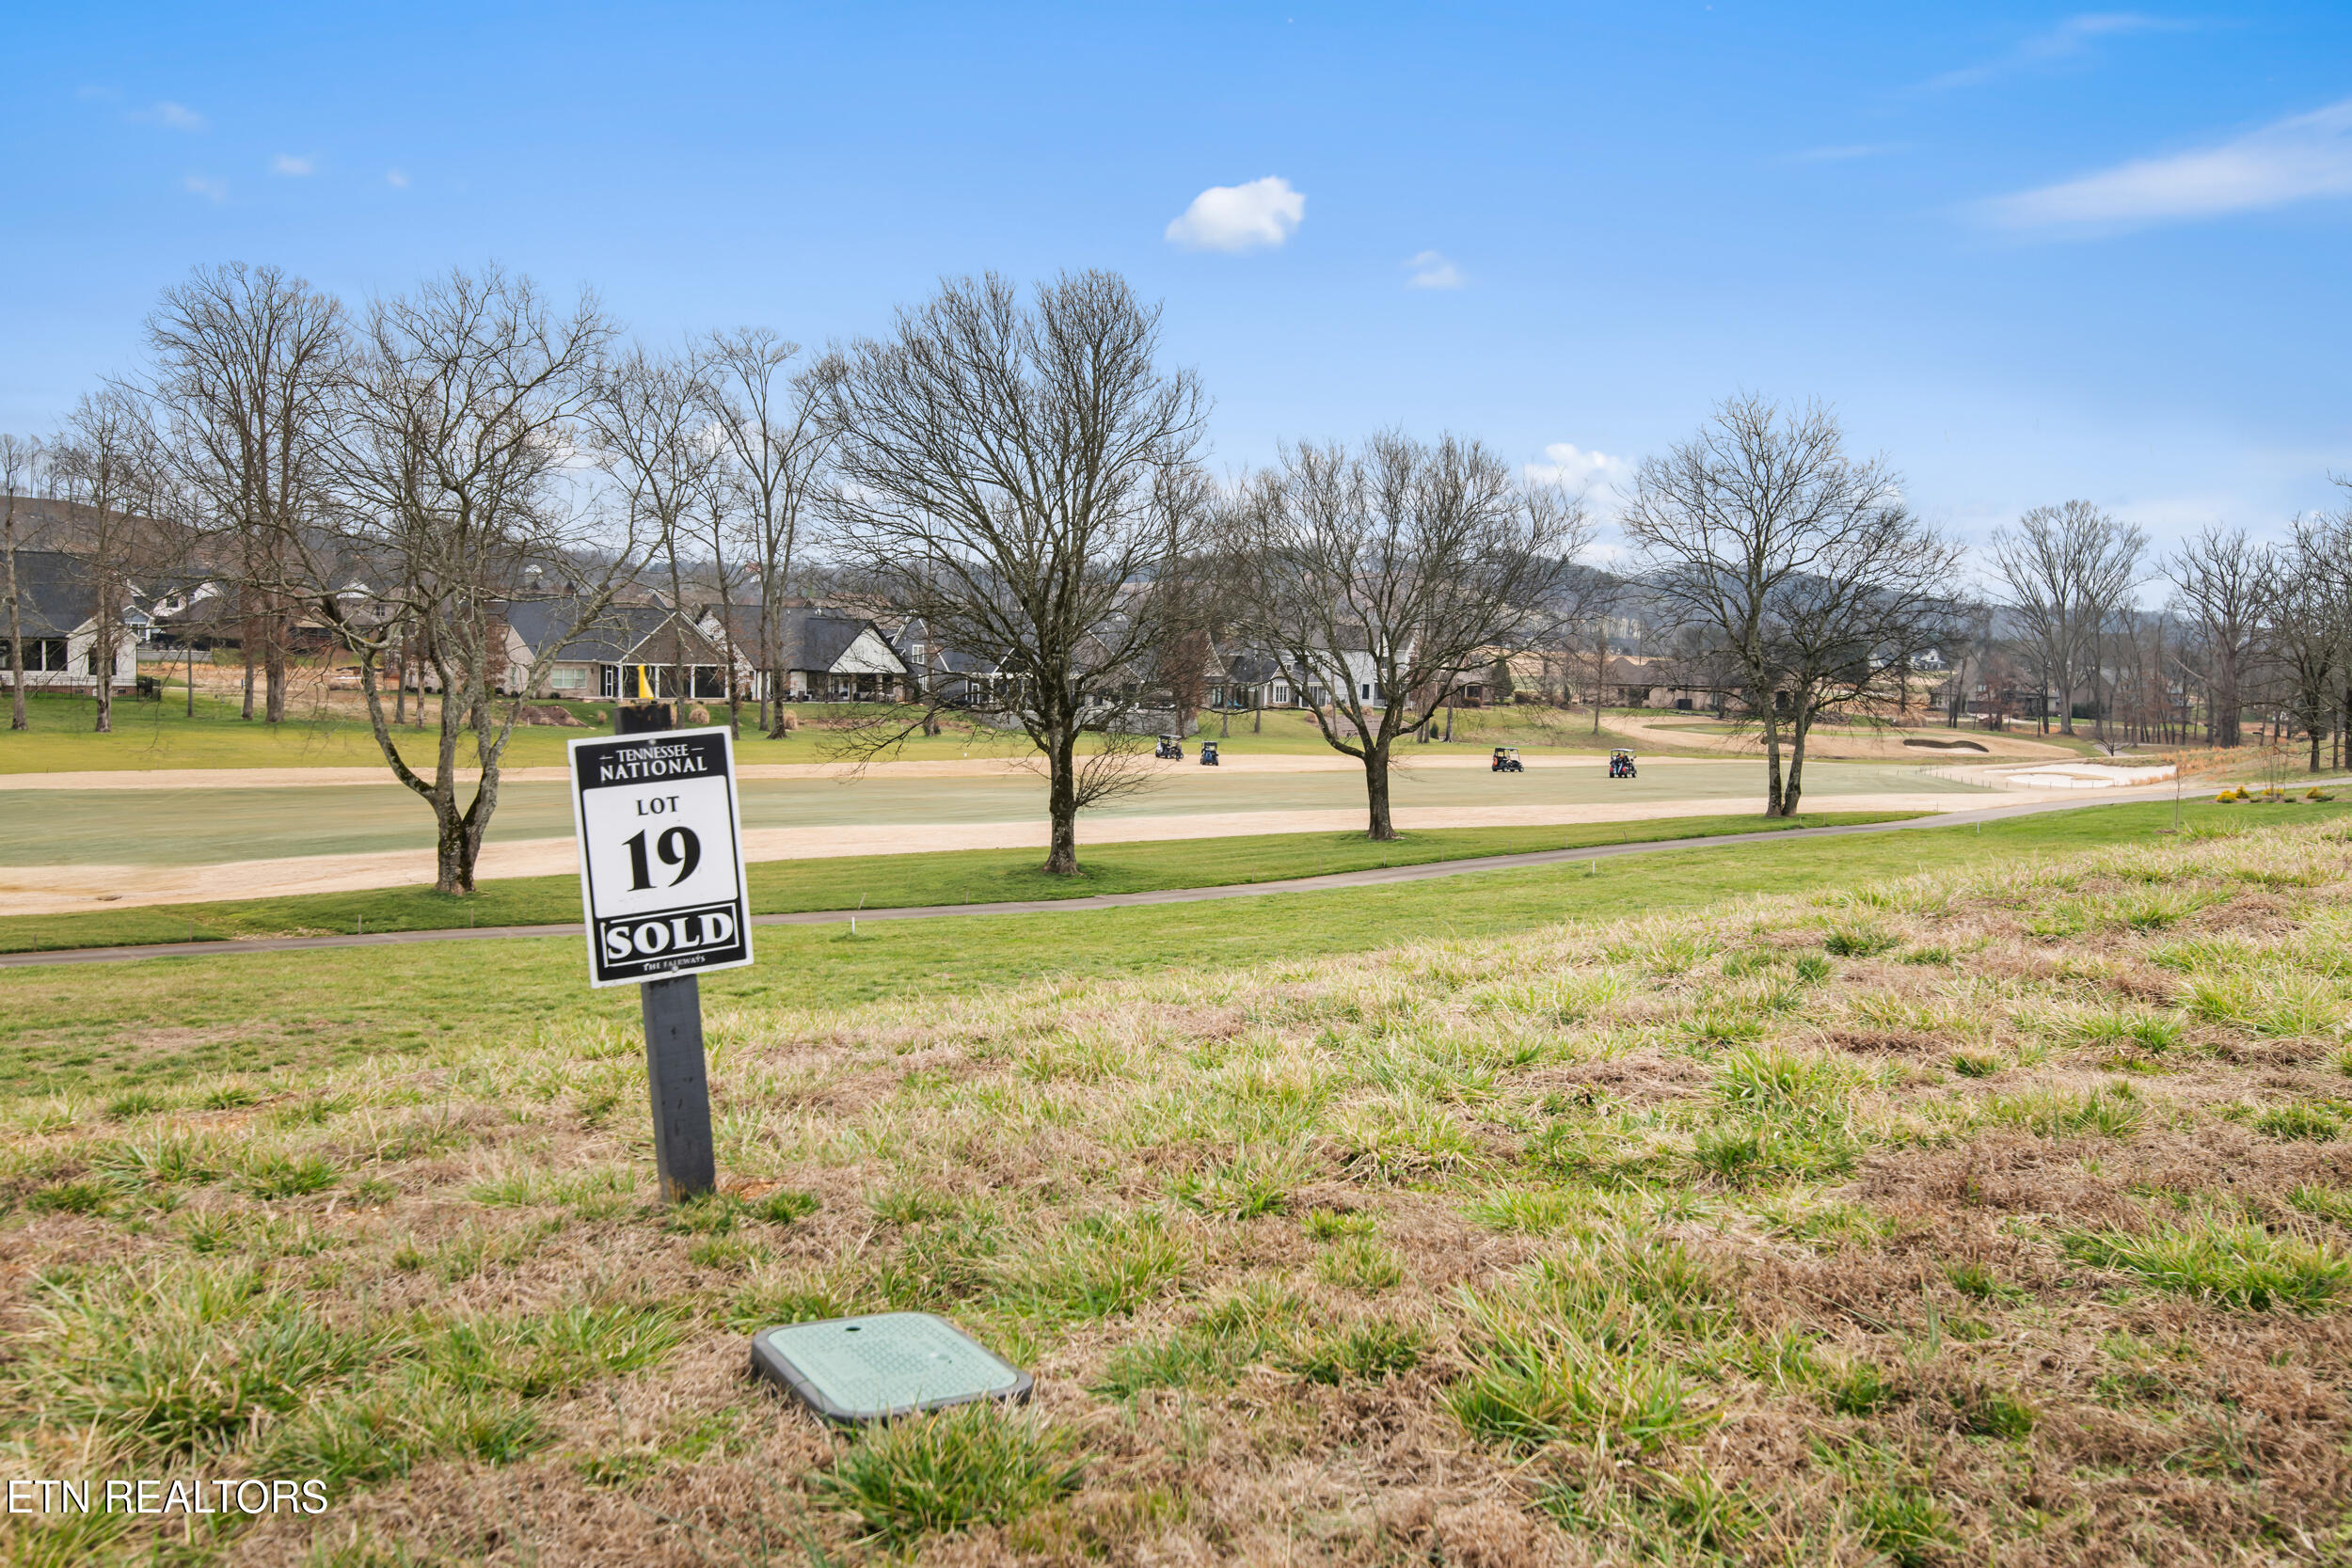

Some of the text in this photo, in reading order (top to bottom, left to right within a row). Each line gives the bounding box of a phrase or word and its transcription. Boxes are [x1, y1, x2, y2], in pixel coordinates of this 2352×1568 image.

[616, 744, 689, 763] TENNESSEE
[599, 756, 707, 782] NATIONAL
[636, 796, 679, 816] LOT
[621, 826, 701, 892] 19
[607, 912, 734, 959] SOLD
